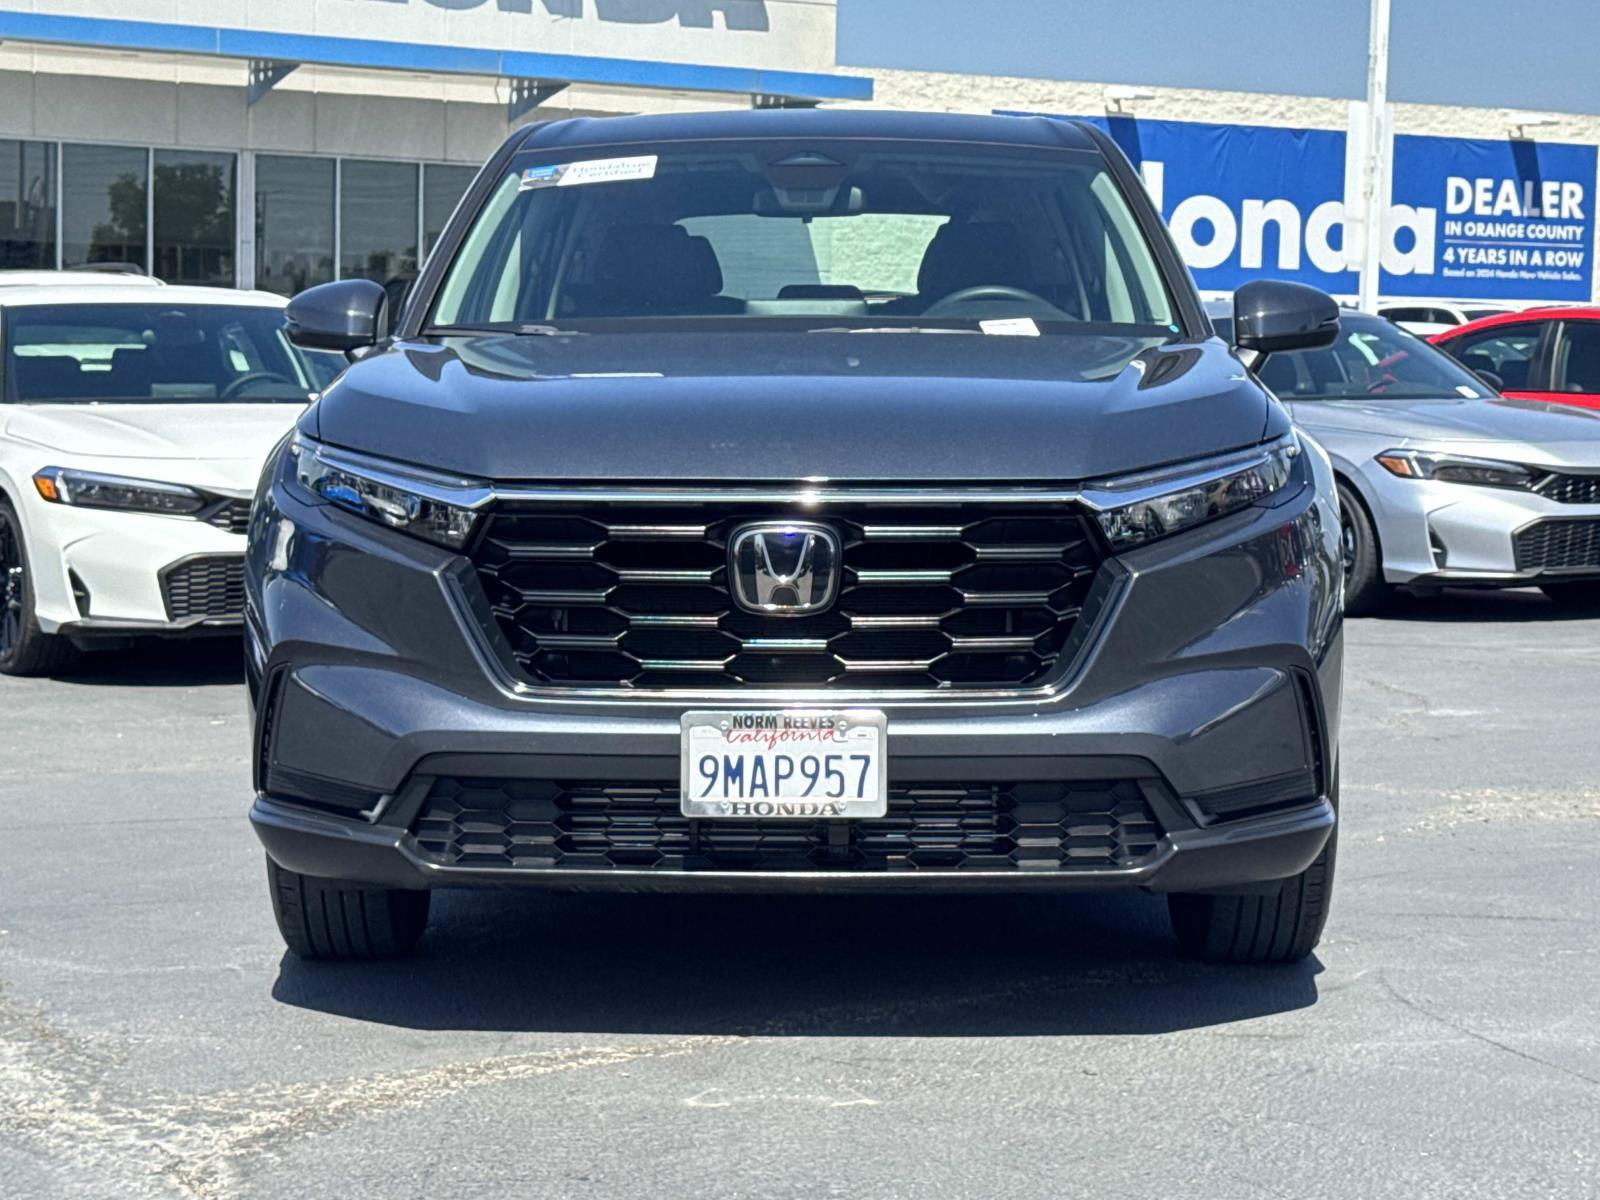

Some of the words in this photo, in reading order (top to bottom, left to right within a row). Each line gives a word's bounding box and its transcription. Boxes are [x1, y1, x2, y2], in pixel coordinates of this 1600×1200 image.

[1446, 176, 1585, 220] DEALER
[1141, 160, 1437, 275] onda
[1444, 220, 1462, 236] IN
[1464, 221, 1525, 239] ORANGE
[1526, 224, 1585, 241] COUNTY
[1443, 246, 1455, 264] 4
[1457, 247, 1508, 266] YEARS
[1509, 249, 1527, 266] IN
[1530, 250, 1542, 267] A
[1545, 251, 1585, 269] ROW
[732, 715, 778, 730] NORM
[783, 716, 835, 730] REEVES
[726, 728, 848, 751] California
[699, 754, 871, 798] 9MAP957
[732, 801, 842, 816] HONDA
